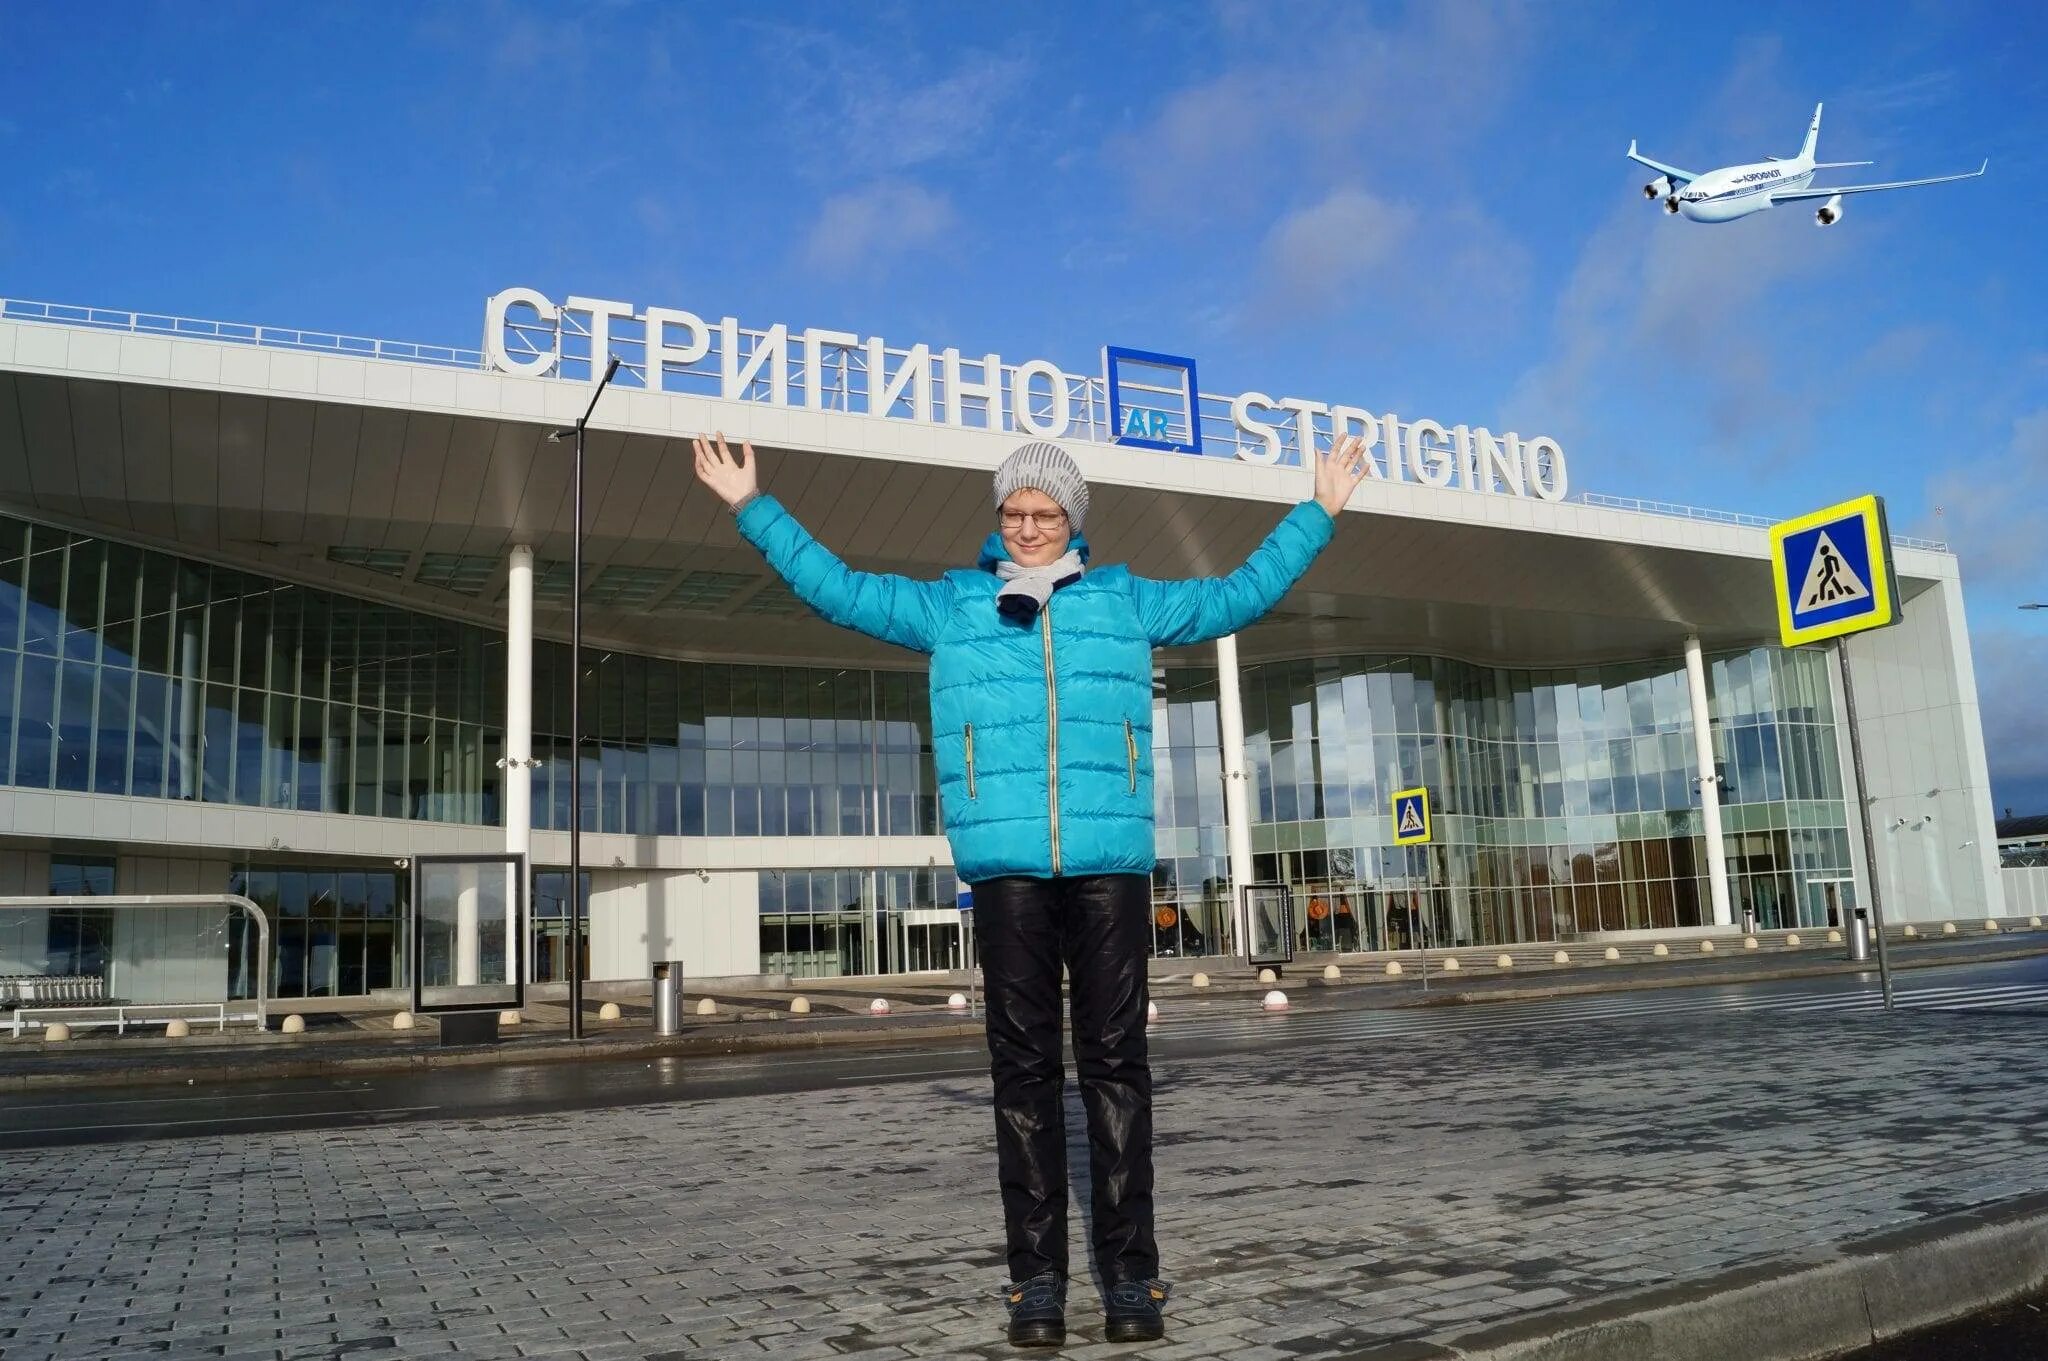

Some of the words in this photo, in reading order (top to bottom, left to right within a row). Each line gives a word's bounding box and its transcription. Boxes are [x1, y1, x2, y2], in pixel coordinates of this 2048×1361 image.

[487, 287, 1070, 439] СТРИГИНО
[1124, 408, 1168, 440] AR
[1231, 392, 1568, 502] STRIGINO
